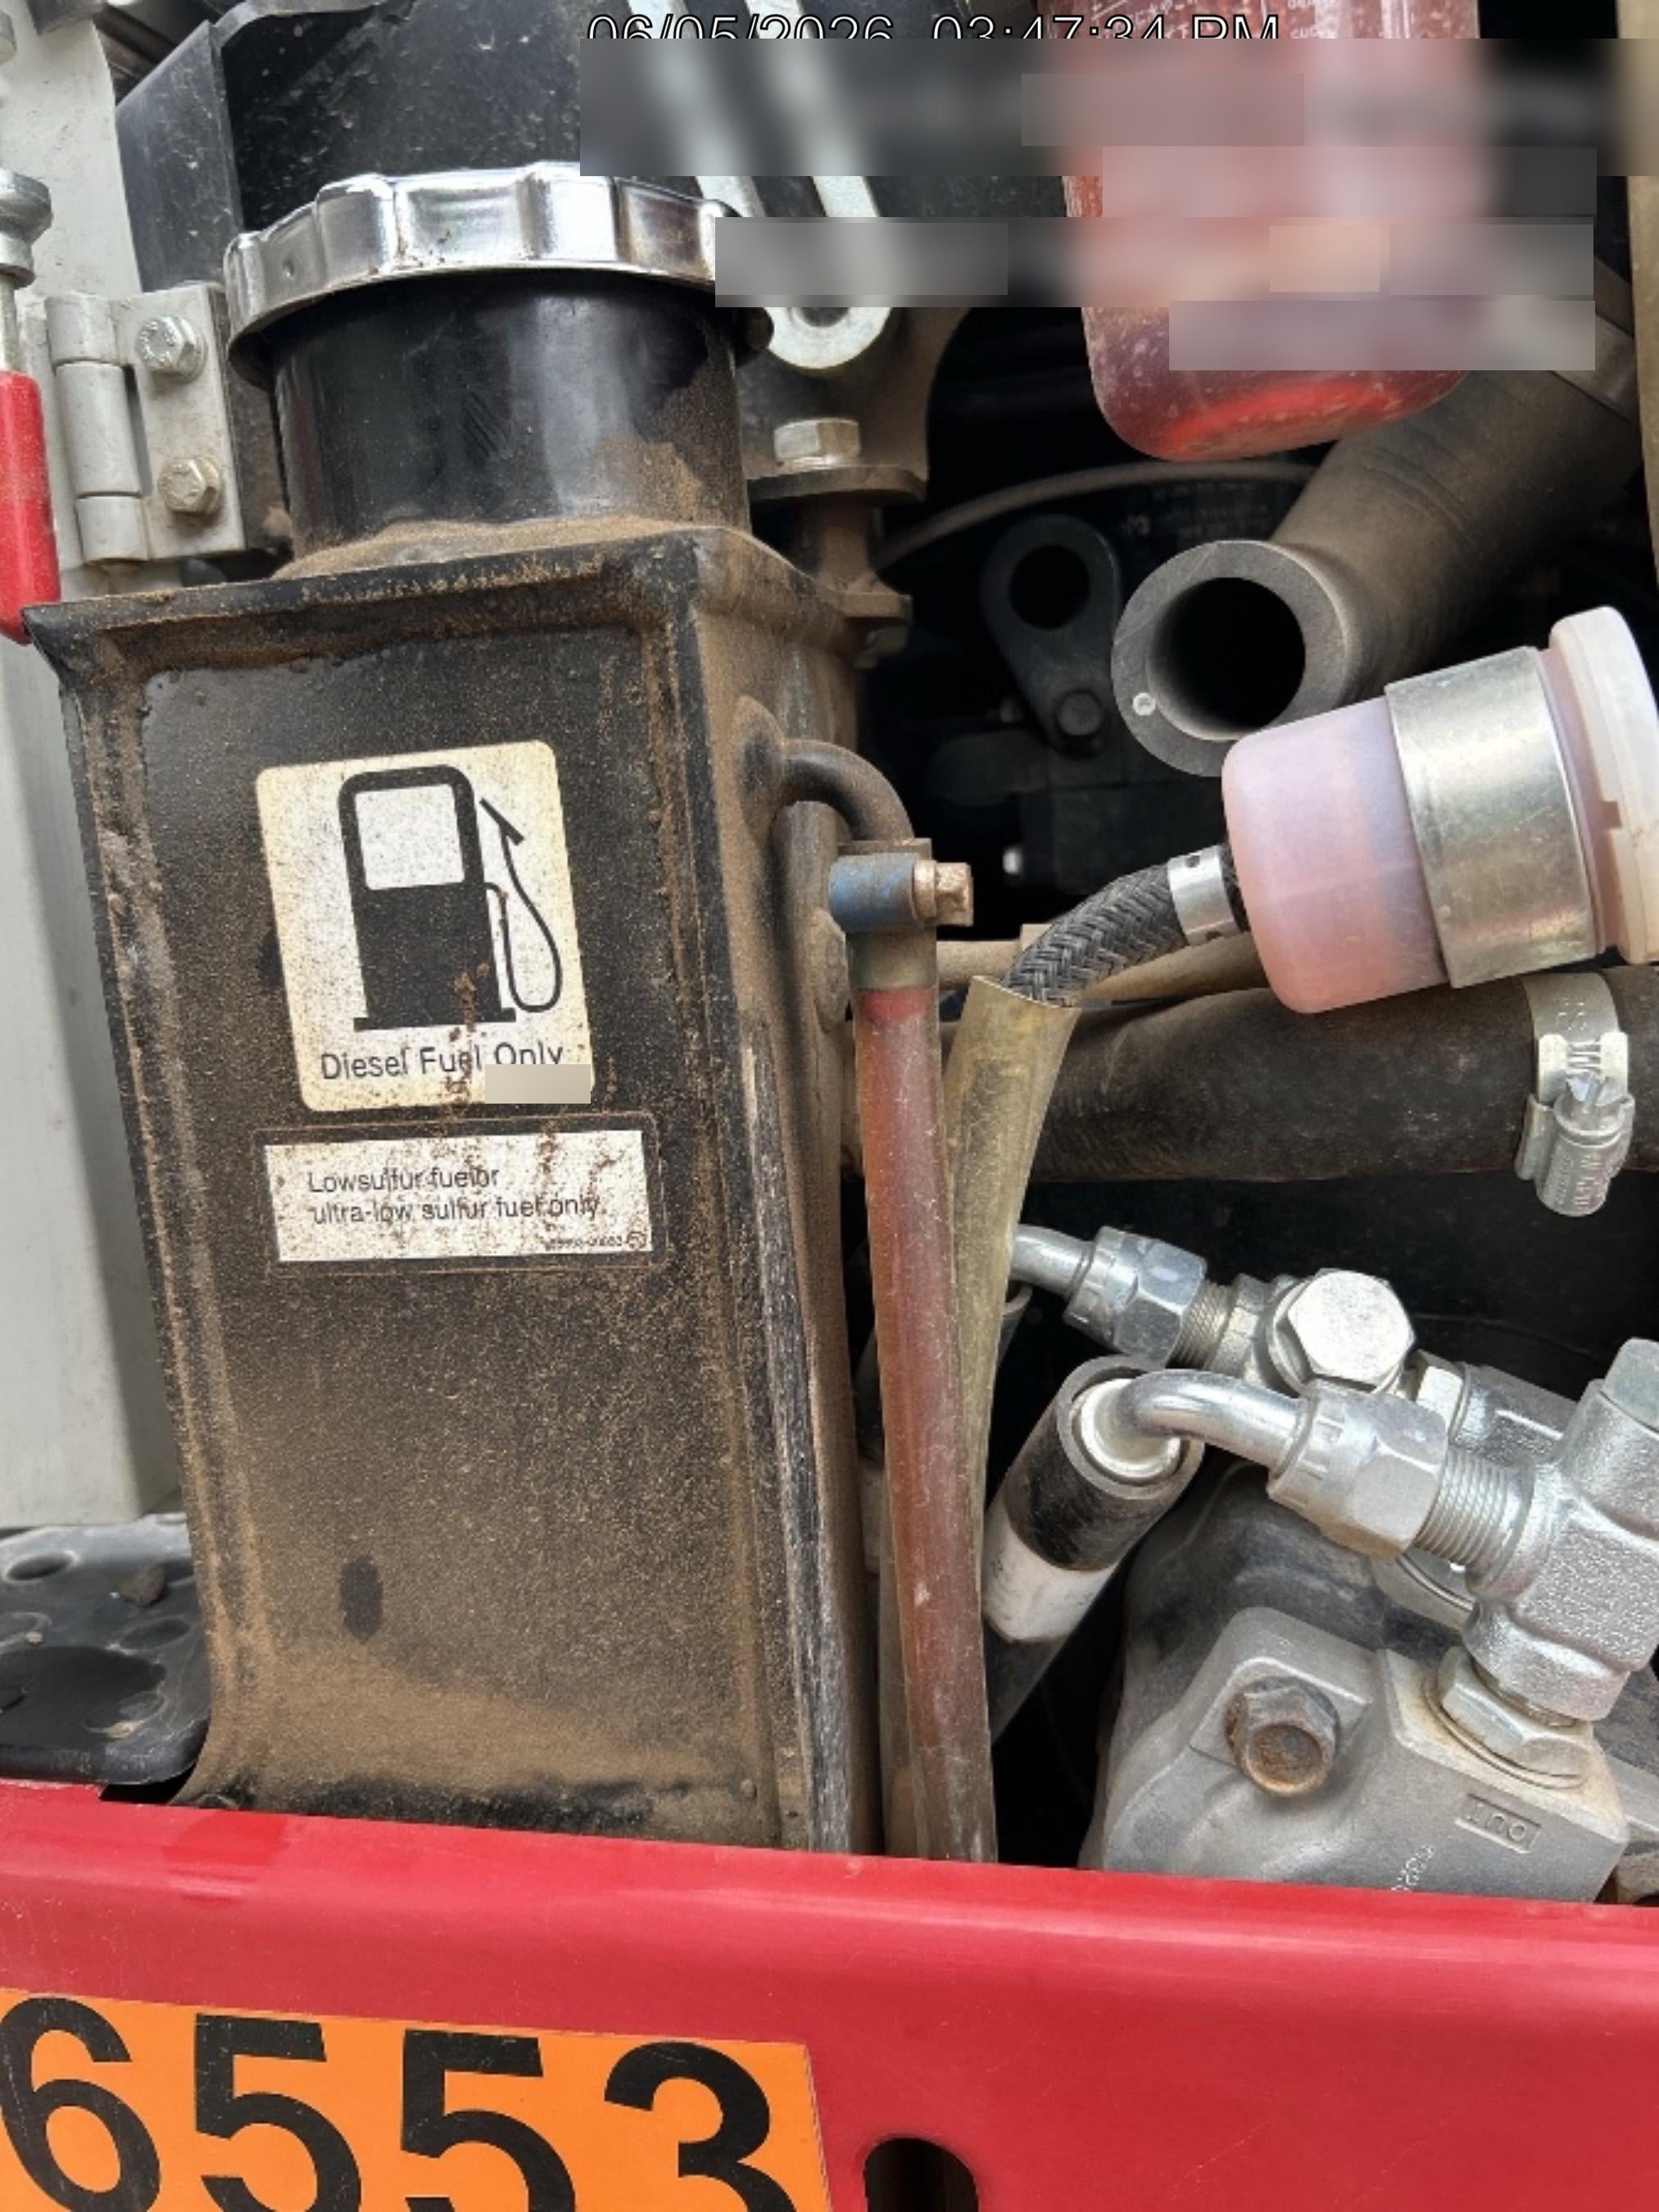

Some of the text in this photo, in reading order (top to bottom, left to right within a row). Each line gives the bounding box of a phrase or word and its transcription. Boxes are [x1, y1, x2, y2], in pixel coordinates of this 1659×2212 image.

[320, 1047, 408, 1079] Diesel
[419, 1045, 482, 1074] Fuel
[313, 1193, 600, 1225] ultra-low sulfur fuel only
[0, 1996, 800, 2212] 6553
